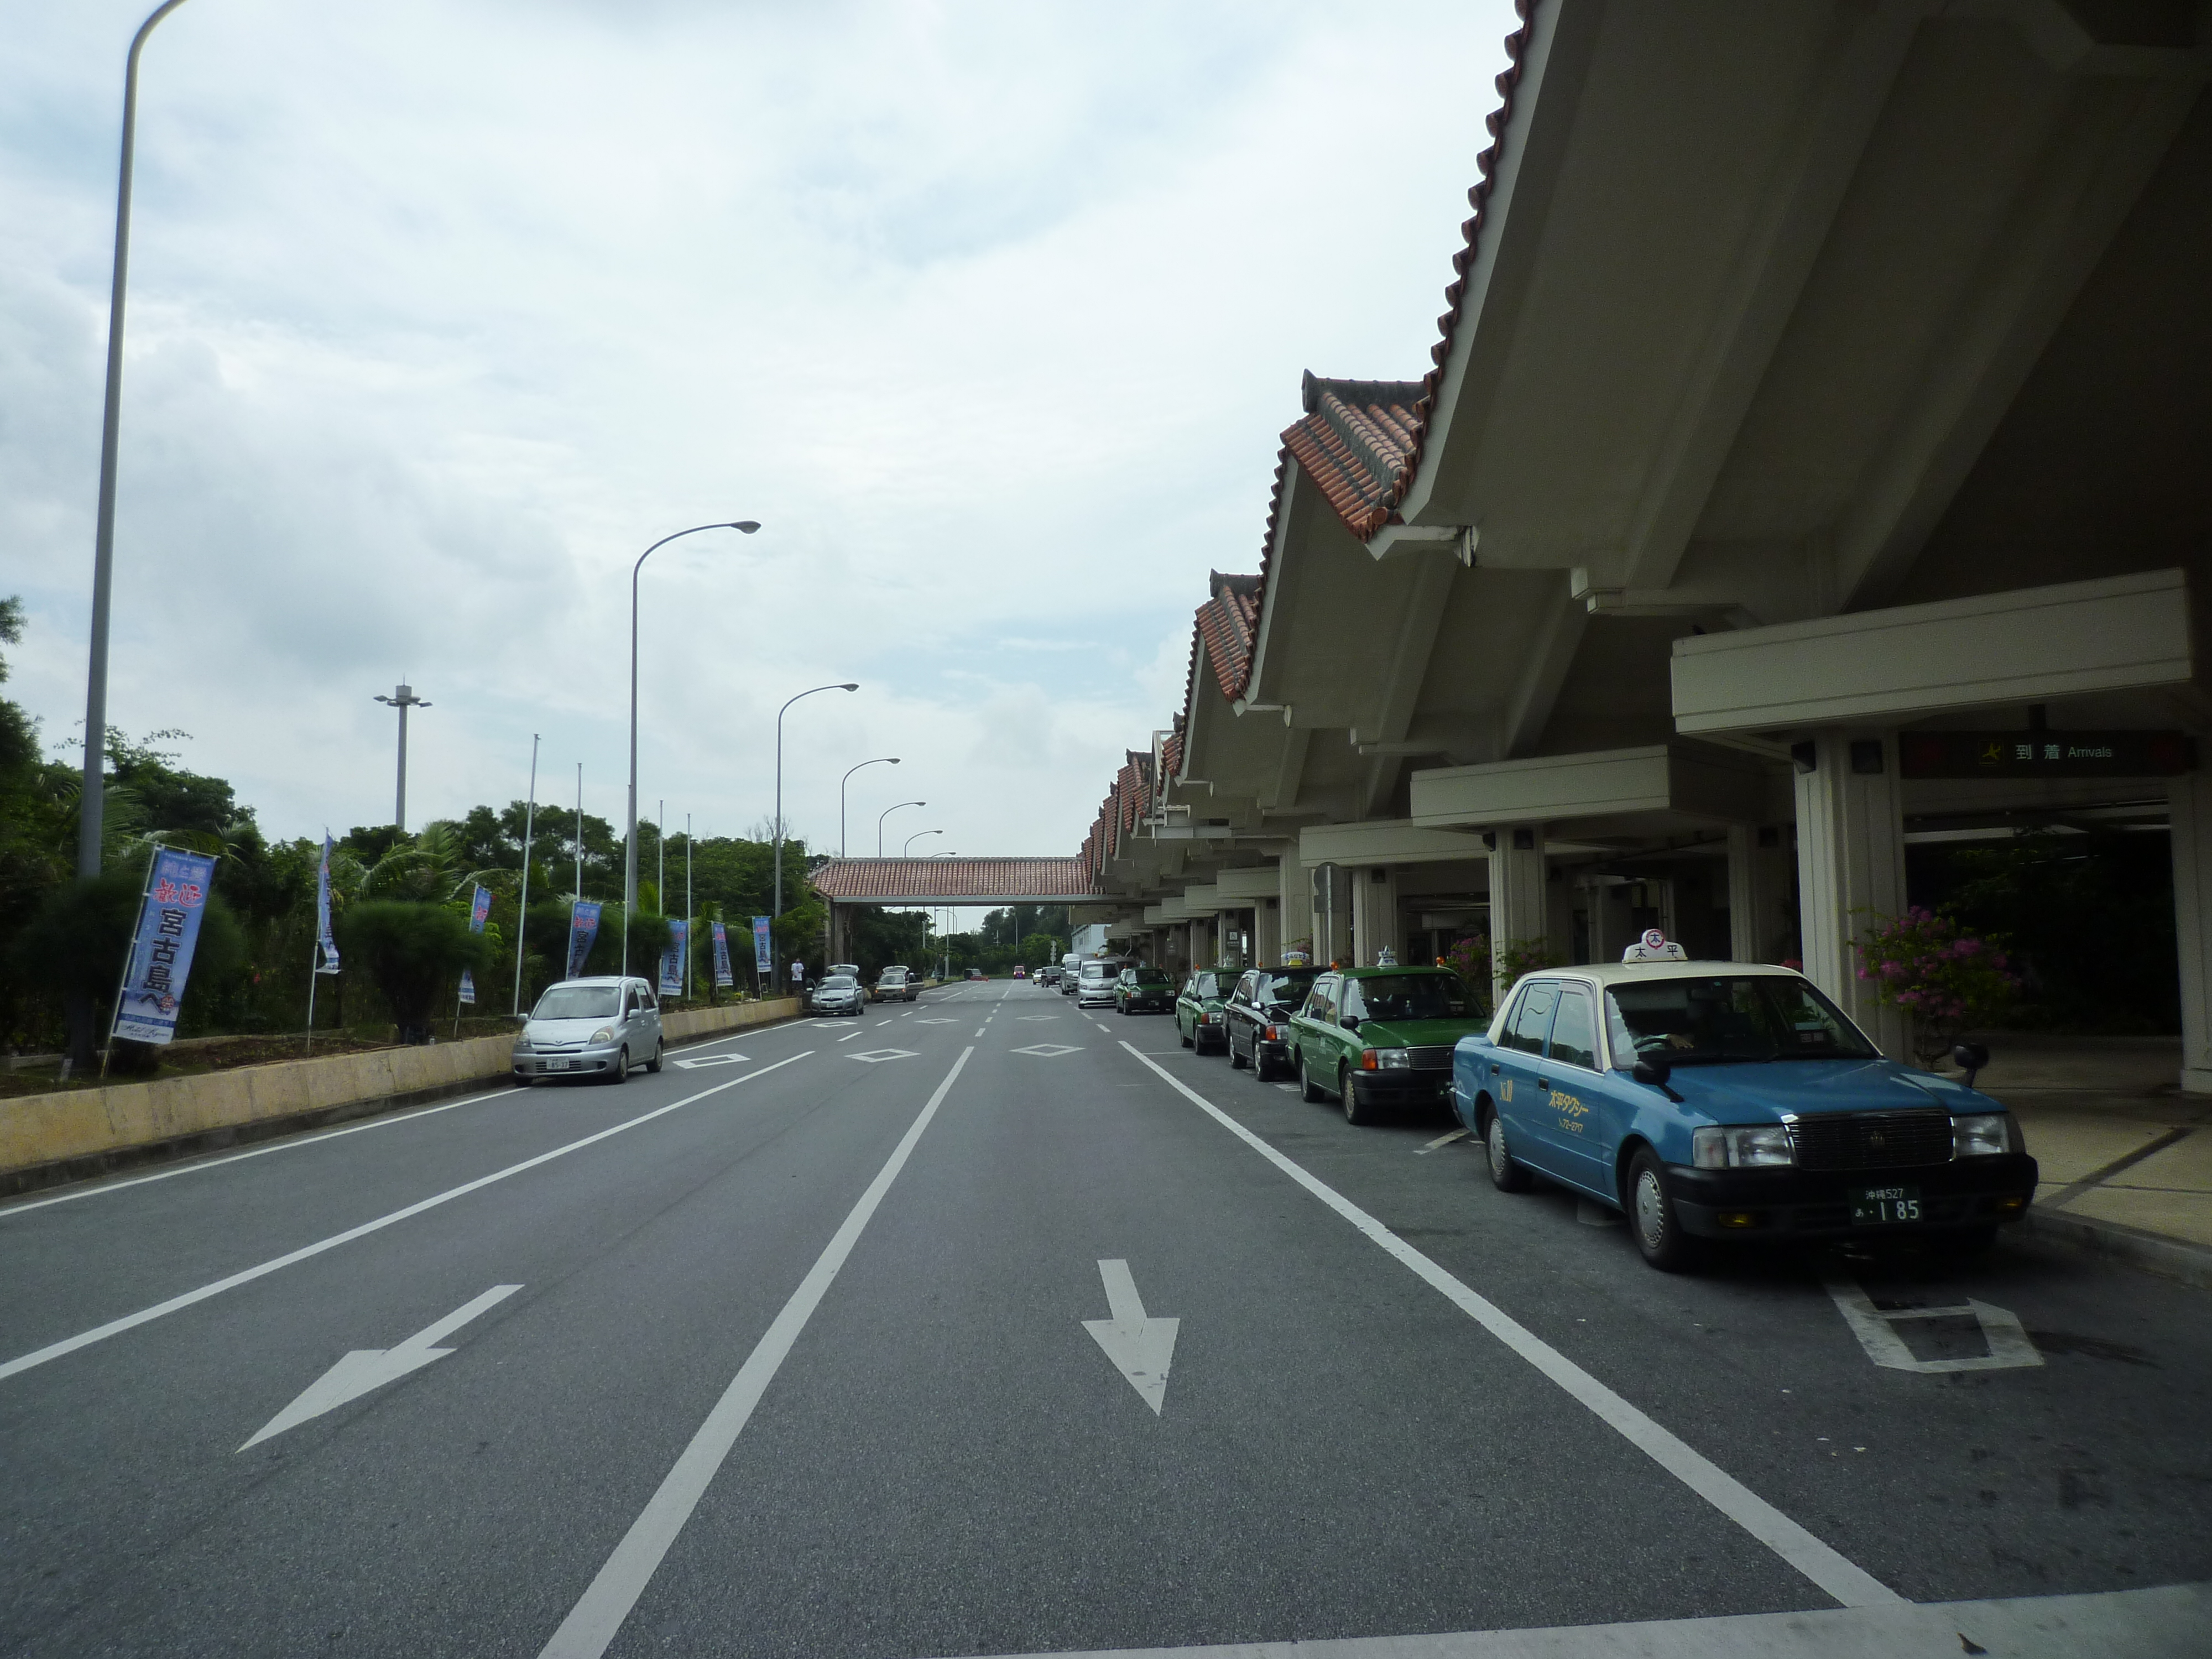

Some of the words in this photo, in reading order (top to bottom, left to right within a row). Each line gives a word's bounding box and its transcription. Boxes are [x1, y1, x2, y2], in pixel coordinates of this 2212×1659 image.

[2016, 744, 2060, 760] 到着
[2068, 747, 2112, 758] Arrivals
[154, 877, 203, 907] 歓迎
[1650, 933, 1661, 943] 太
[138, 907, 187, 1015] 宮古島へ
[1635, 945, 1678, 958] 太平
[1549, 1090, 1589, 1117] 太平タクシー
